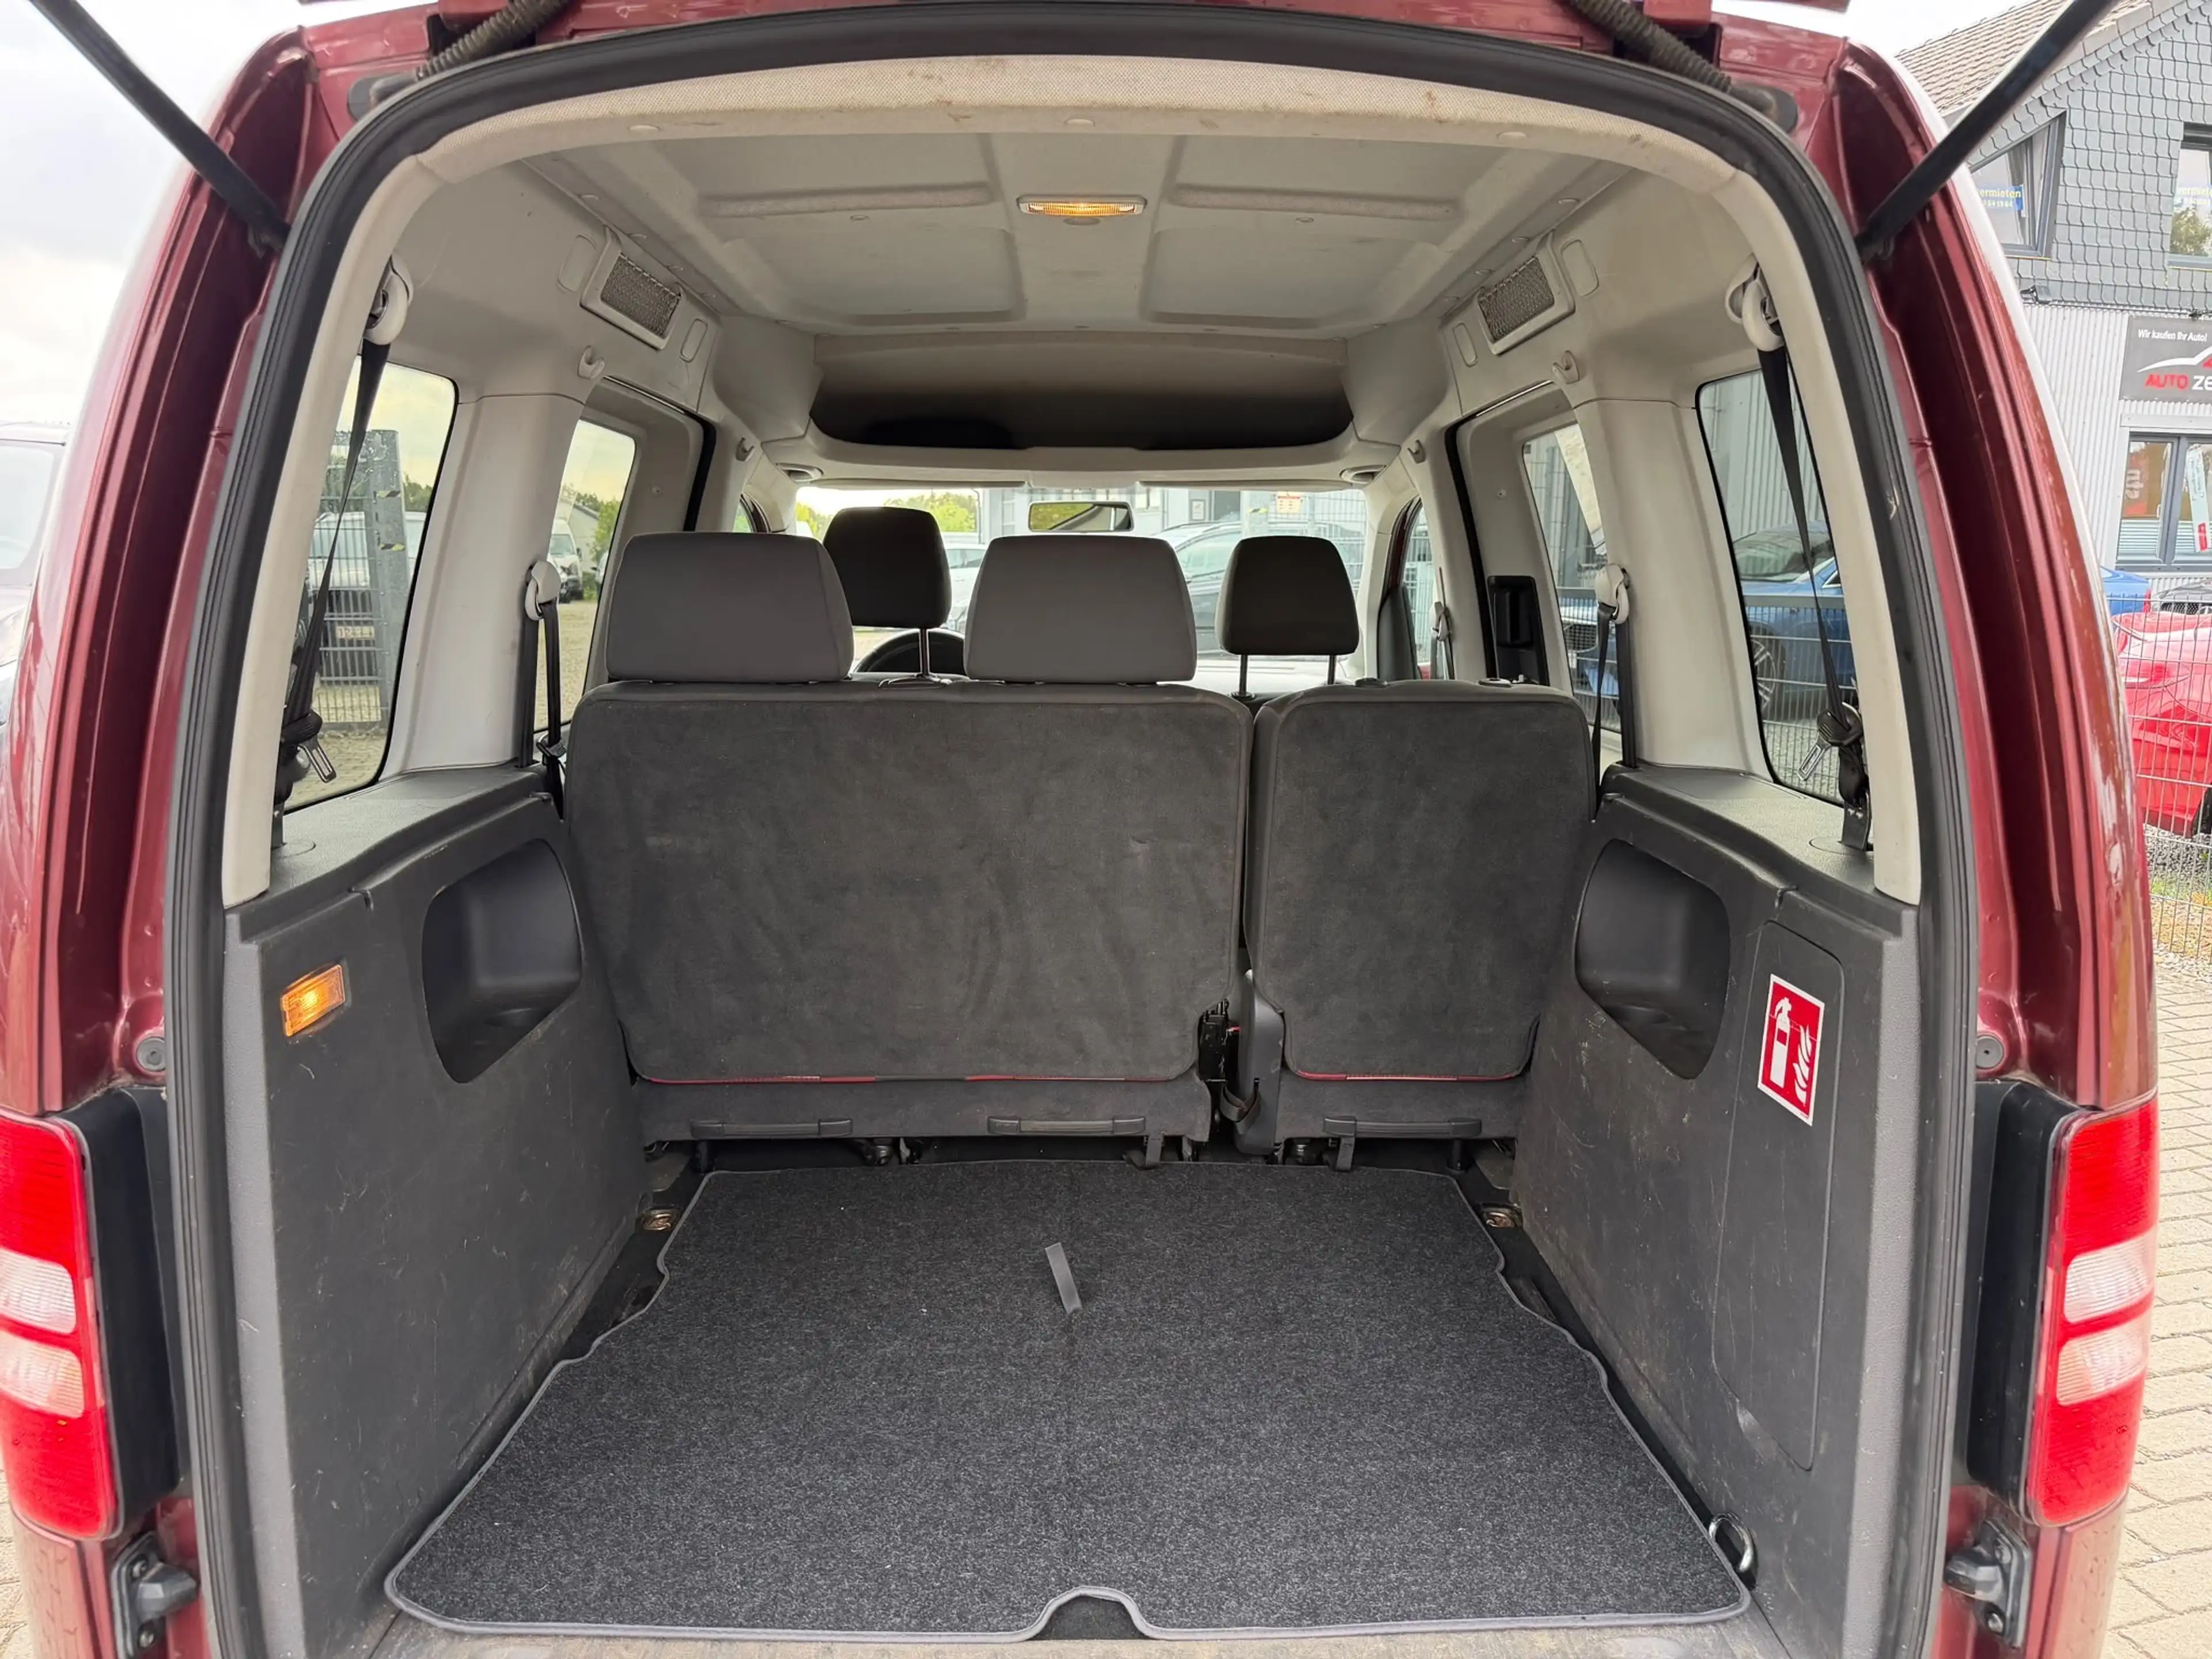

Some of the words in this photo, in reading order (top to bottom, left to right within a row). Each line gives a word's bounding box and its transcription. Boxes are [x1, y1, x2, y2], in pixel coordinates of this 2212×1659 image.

[1979, 188, 2021, 198] ermieten
[2138, 328, 2151, 338] Wir
[2151, 329, 2176, 339] kaufen
[2177, 331, 2187, 340] Ihr
[2187, 332, 2208, 342] Auto!
[2145, 373, 2188, 389] AUTO
